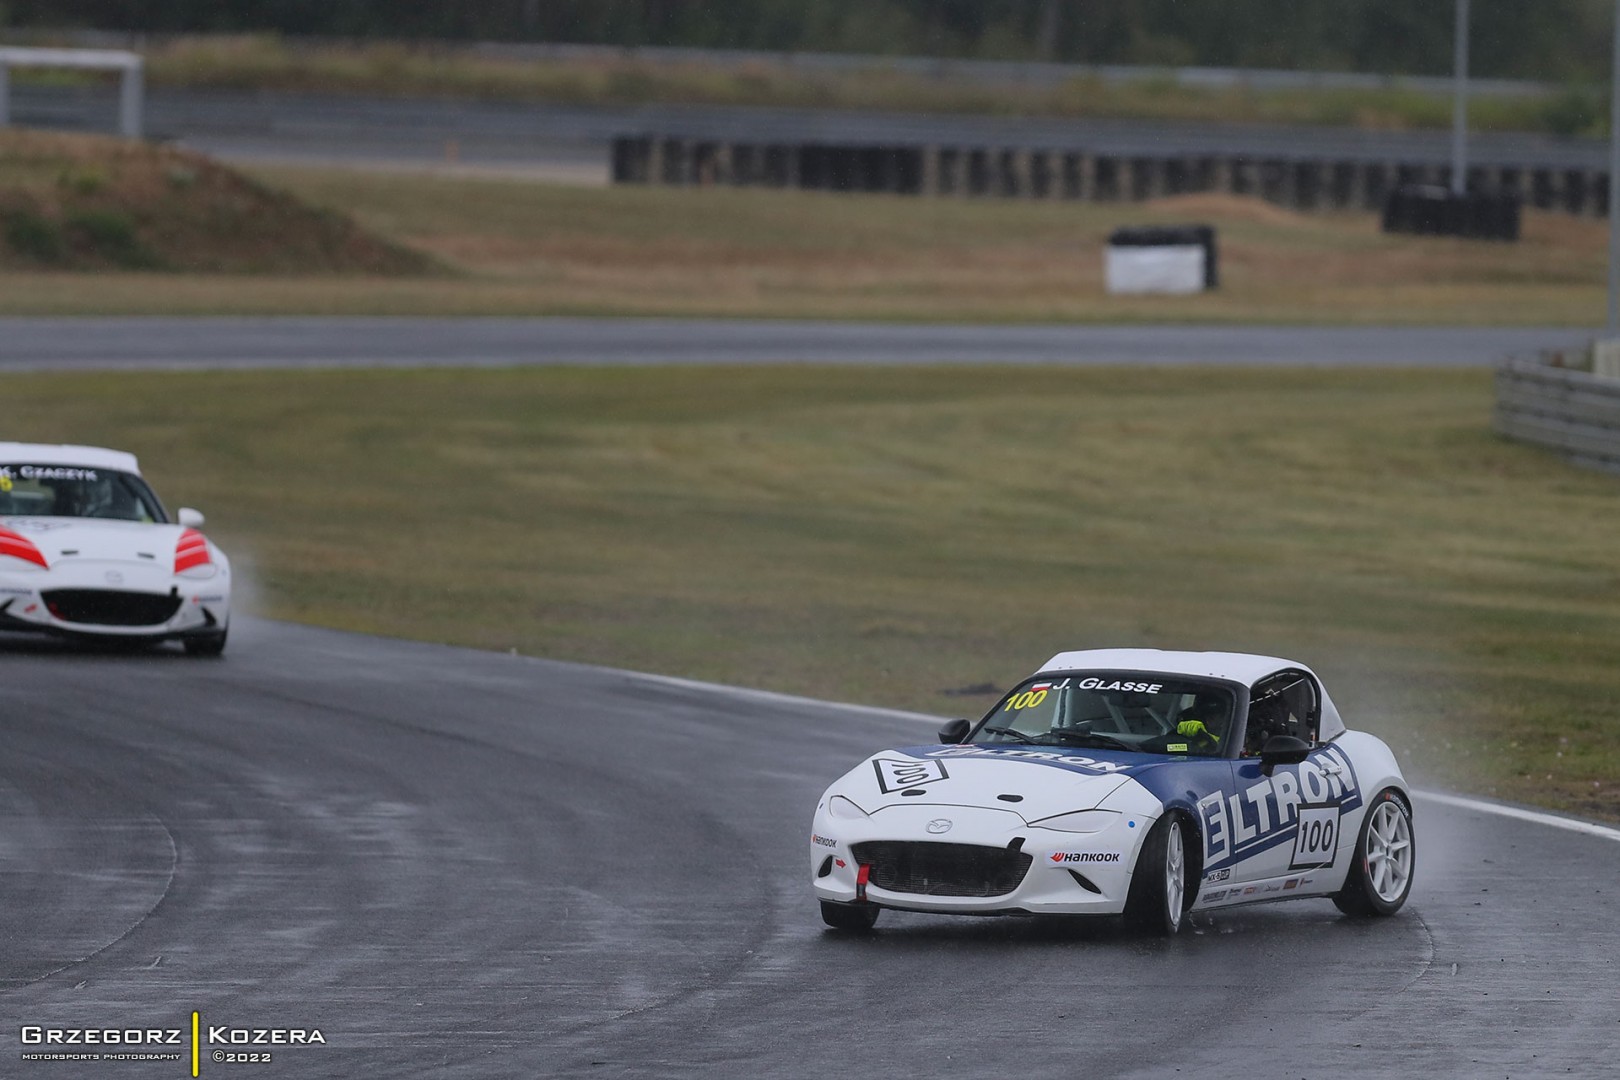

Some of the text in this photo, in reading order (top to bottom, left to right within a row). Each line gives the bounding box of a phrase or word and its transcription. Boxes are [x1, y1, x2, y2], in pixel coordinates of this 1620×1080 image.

[20, 465, 98, 482] CZACZYK
[1052, 677, 1163, 694] J. GLASSE
[1003, 690, 1048, 712] 100
[924, 747, 1133, 774] ELTRON
[1196, 747, 1356, 869] ELTRON
[1299, 818, 1335, 854] 100
